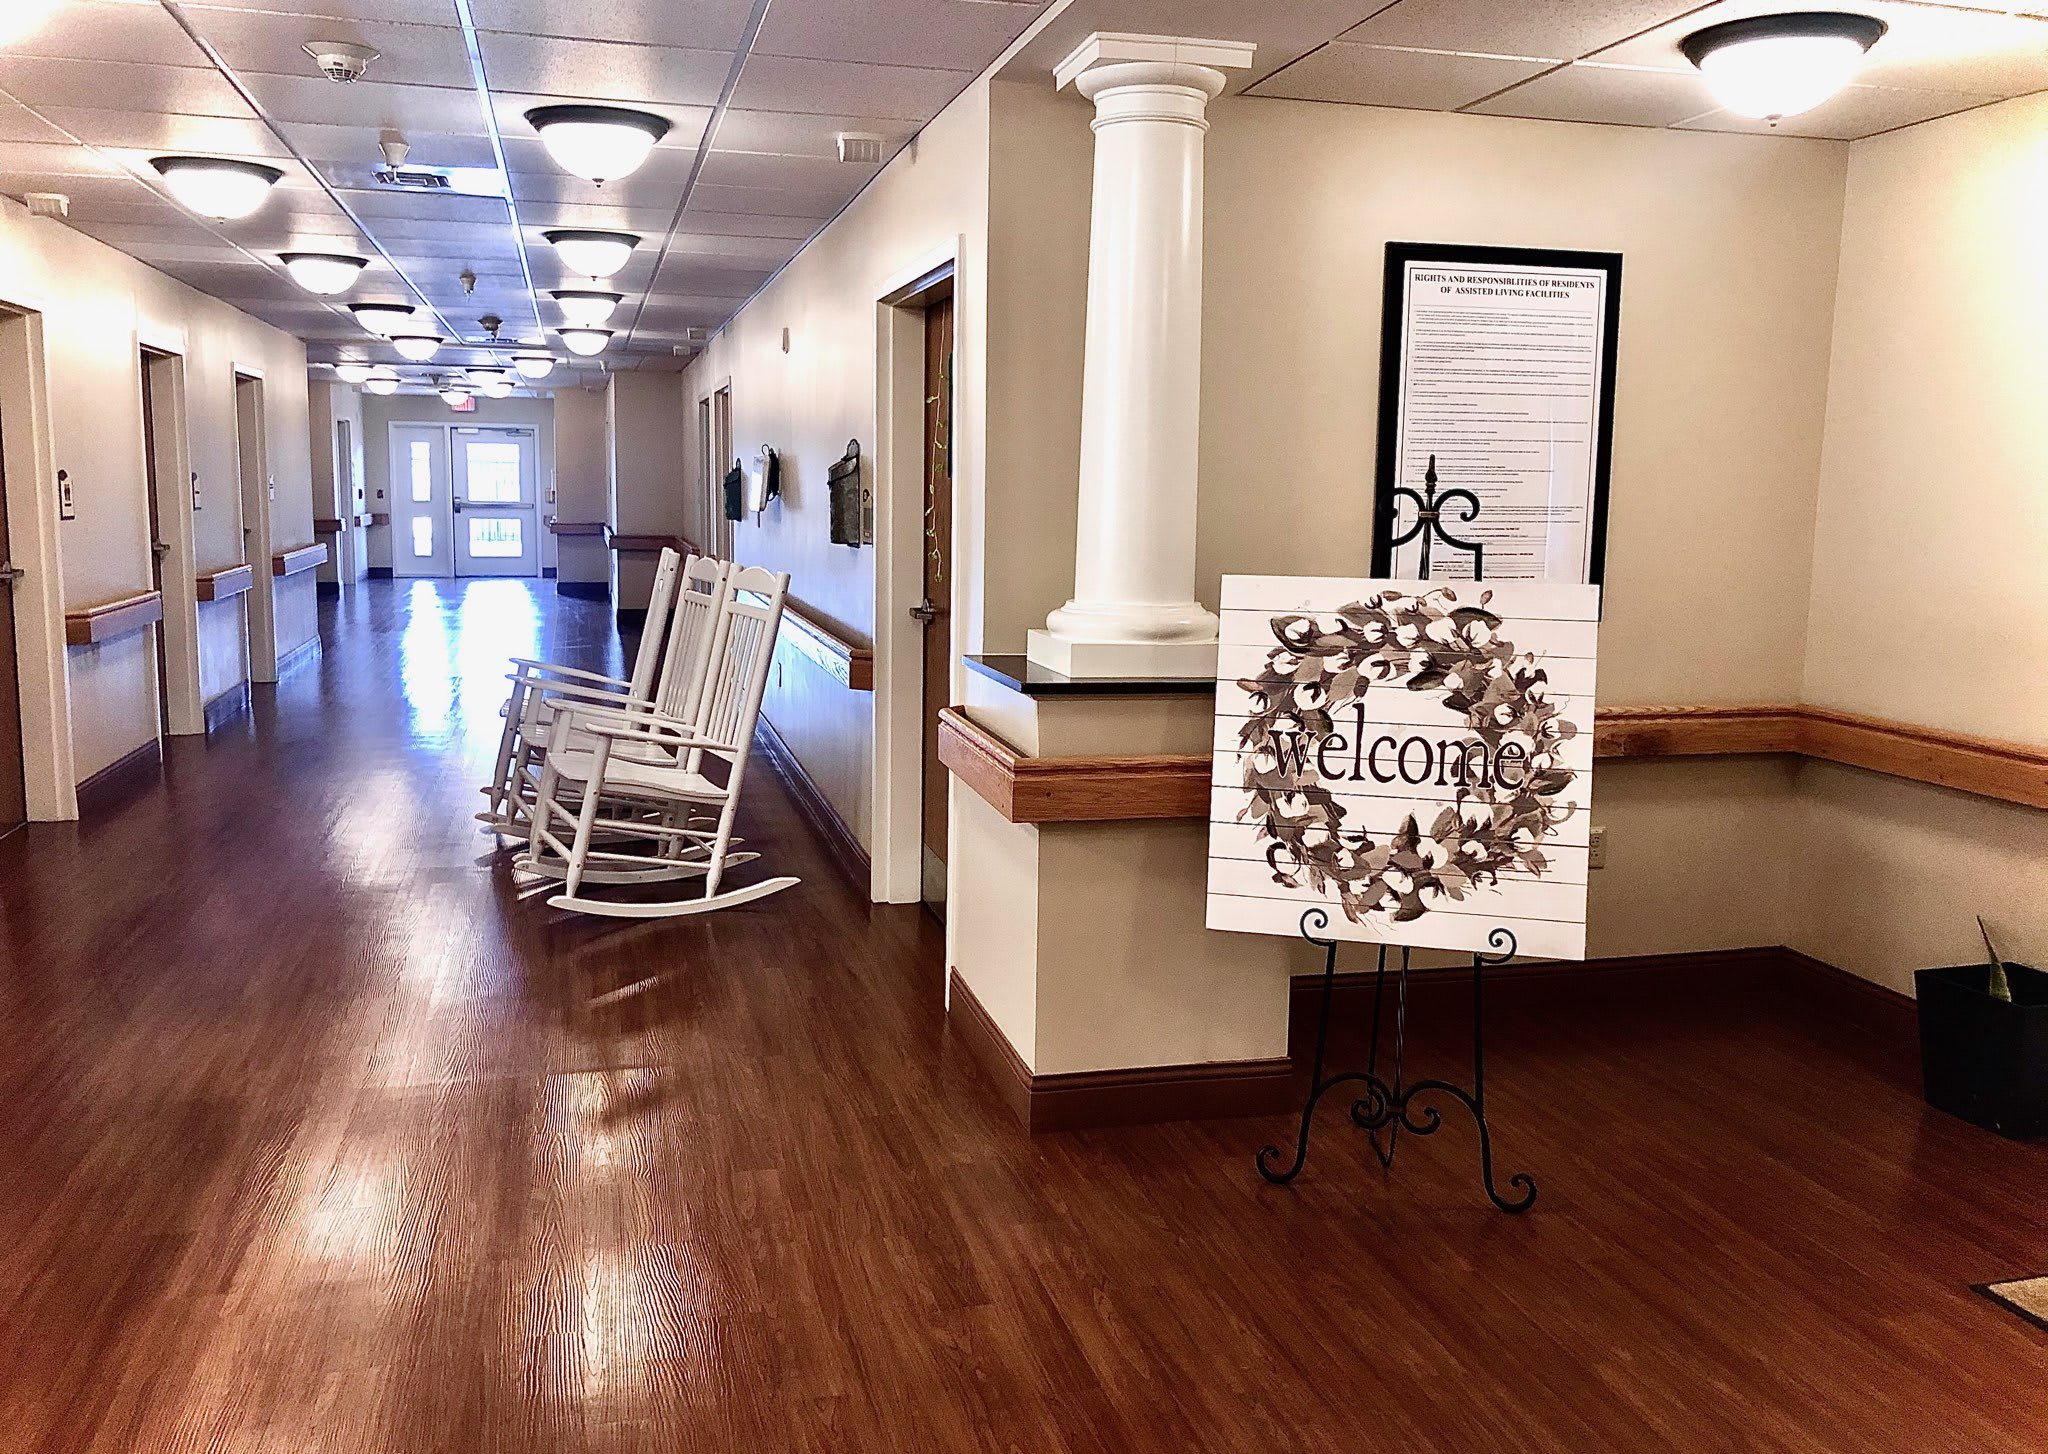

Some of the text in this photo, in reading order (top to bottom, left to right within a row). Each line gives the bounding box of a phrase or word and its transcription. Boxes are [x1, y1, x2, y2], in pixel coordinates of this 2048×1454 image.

[1415, 274, 1446, 282] RIGHTS
[1551, 280, 1595, 289] RESIDENTS
[1440, 286, 1570, 298] OF ASSISTED LIVING FACILITIES
[1267, 703, 1525, 789] welcome
